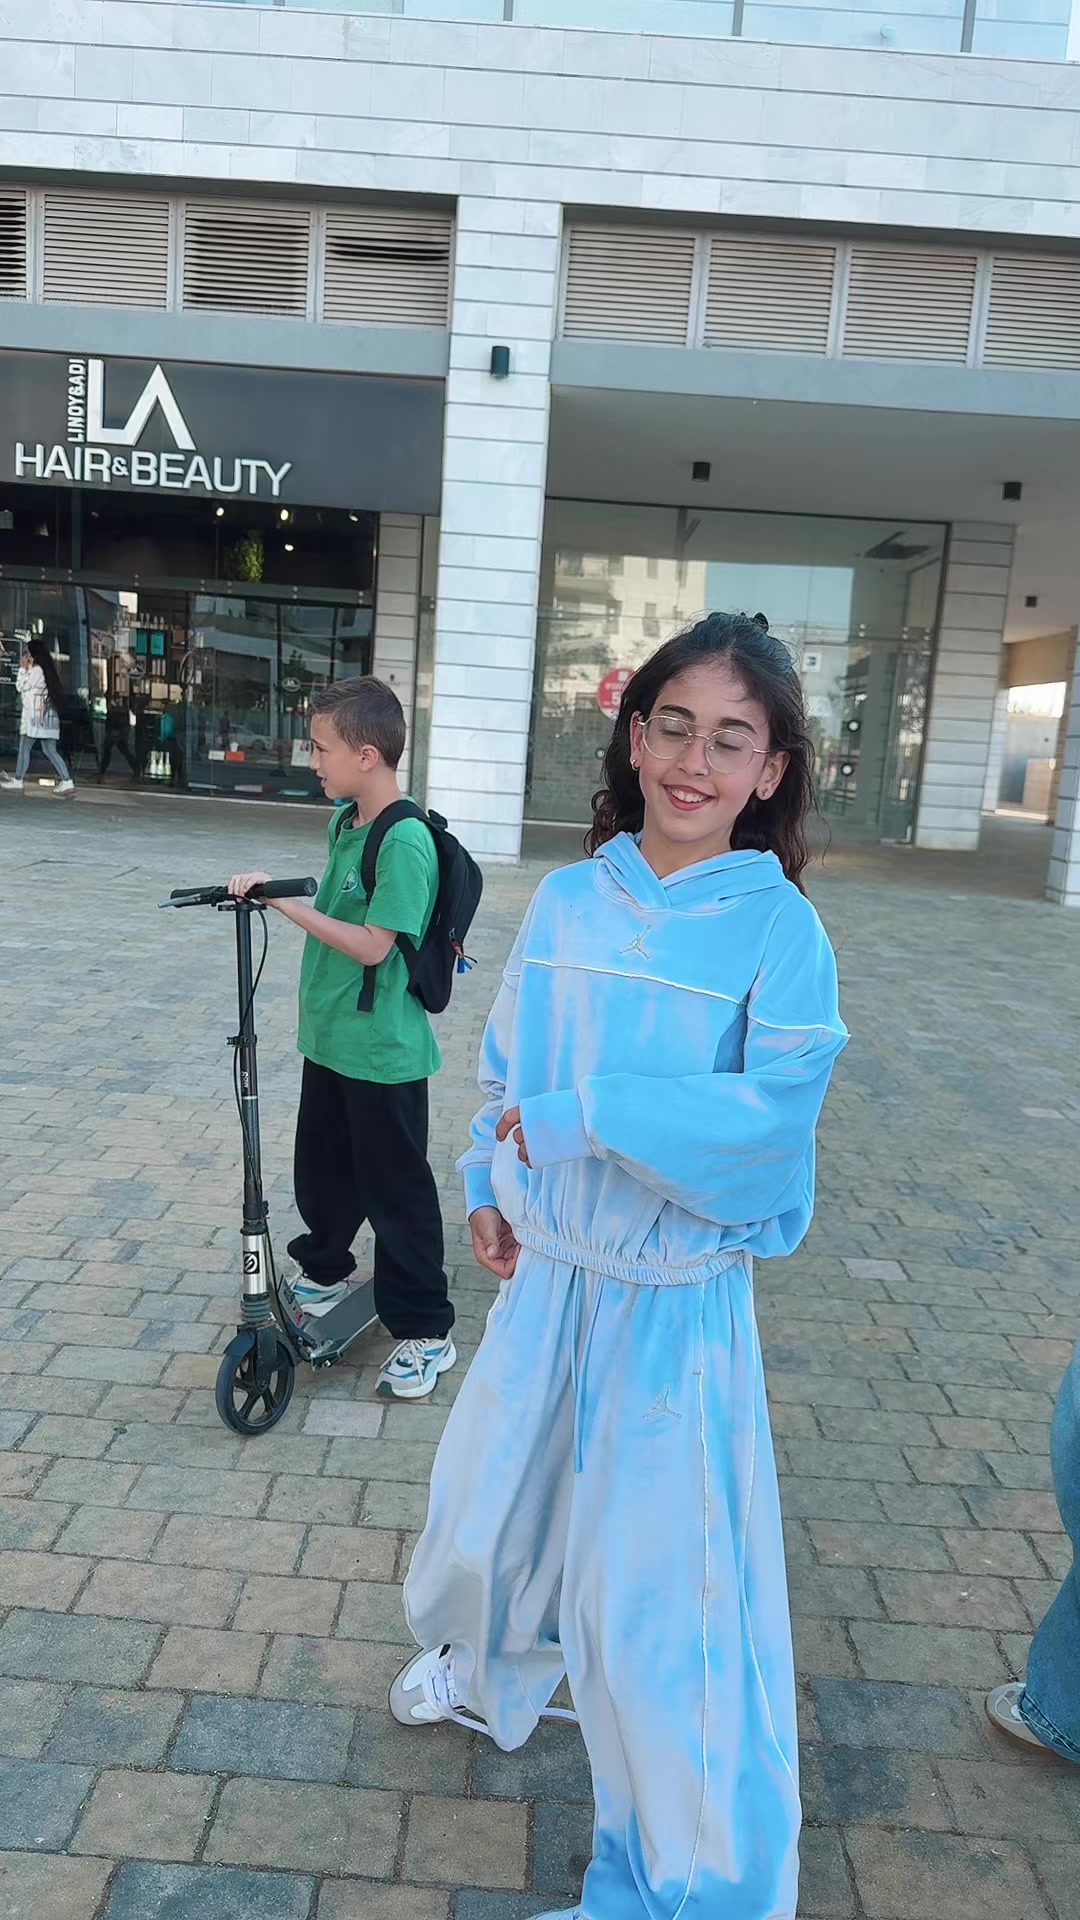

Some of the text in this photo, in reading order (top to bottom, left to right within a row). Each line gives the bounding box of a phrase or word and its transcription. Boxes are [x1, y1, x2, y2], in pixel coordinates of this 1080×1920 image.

[67, 358, 86, 443] LINOY&ADI
[87, 358, 196, 450] LA
[15, 442, 292, 496] HAIR&BEAUTY
